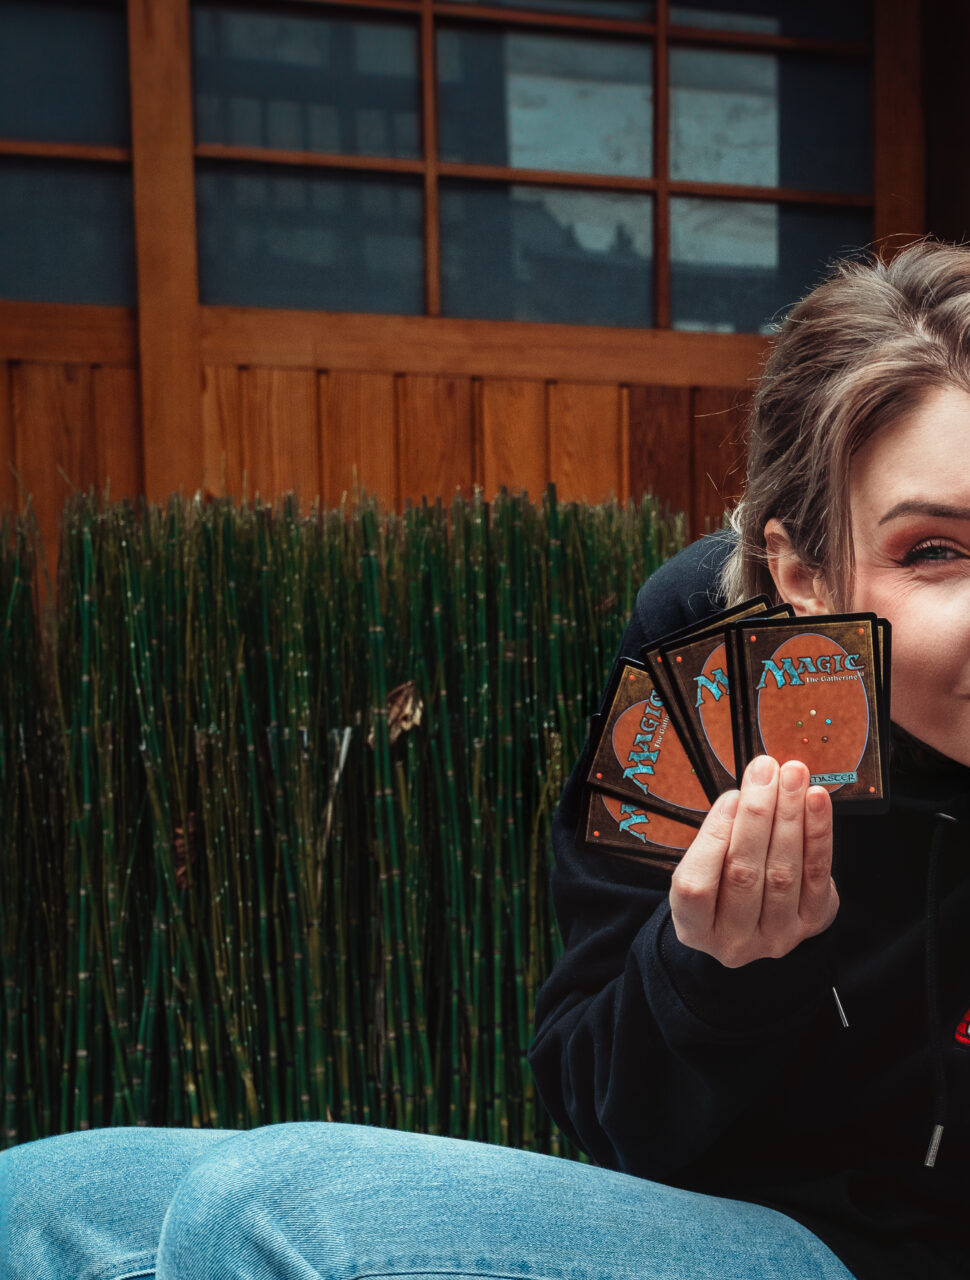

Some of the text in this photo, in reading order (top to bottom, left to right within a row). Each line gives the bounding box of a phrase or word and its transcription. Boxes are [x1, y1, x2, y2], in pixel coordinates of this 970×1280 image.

[756, 654, 865, 690] MAGIC
[820, 674, 858, 683] Gathering
[810, 773, 855, 783] MASTER
